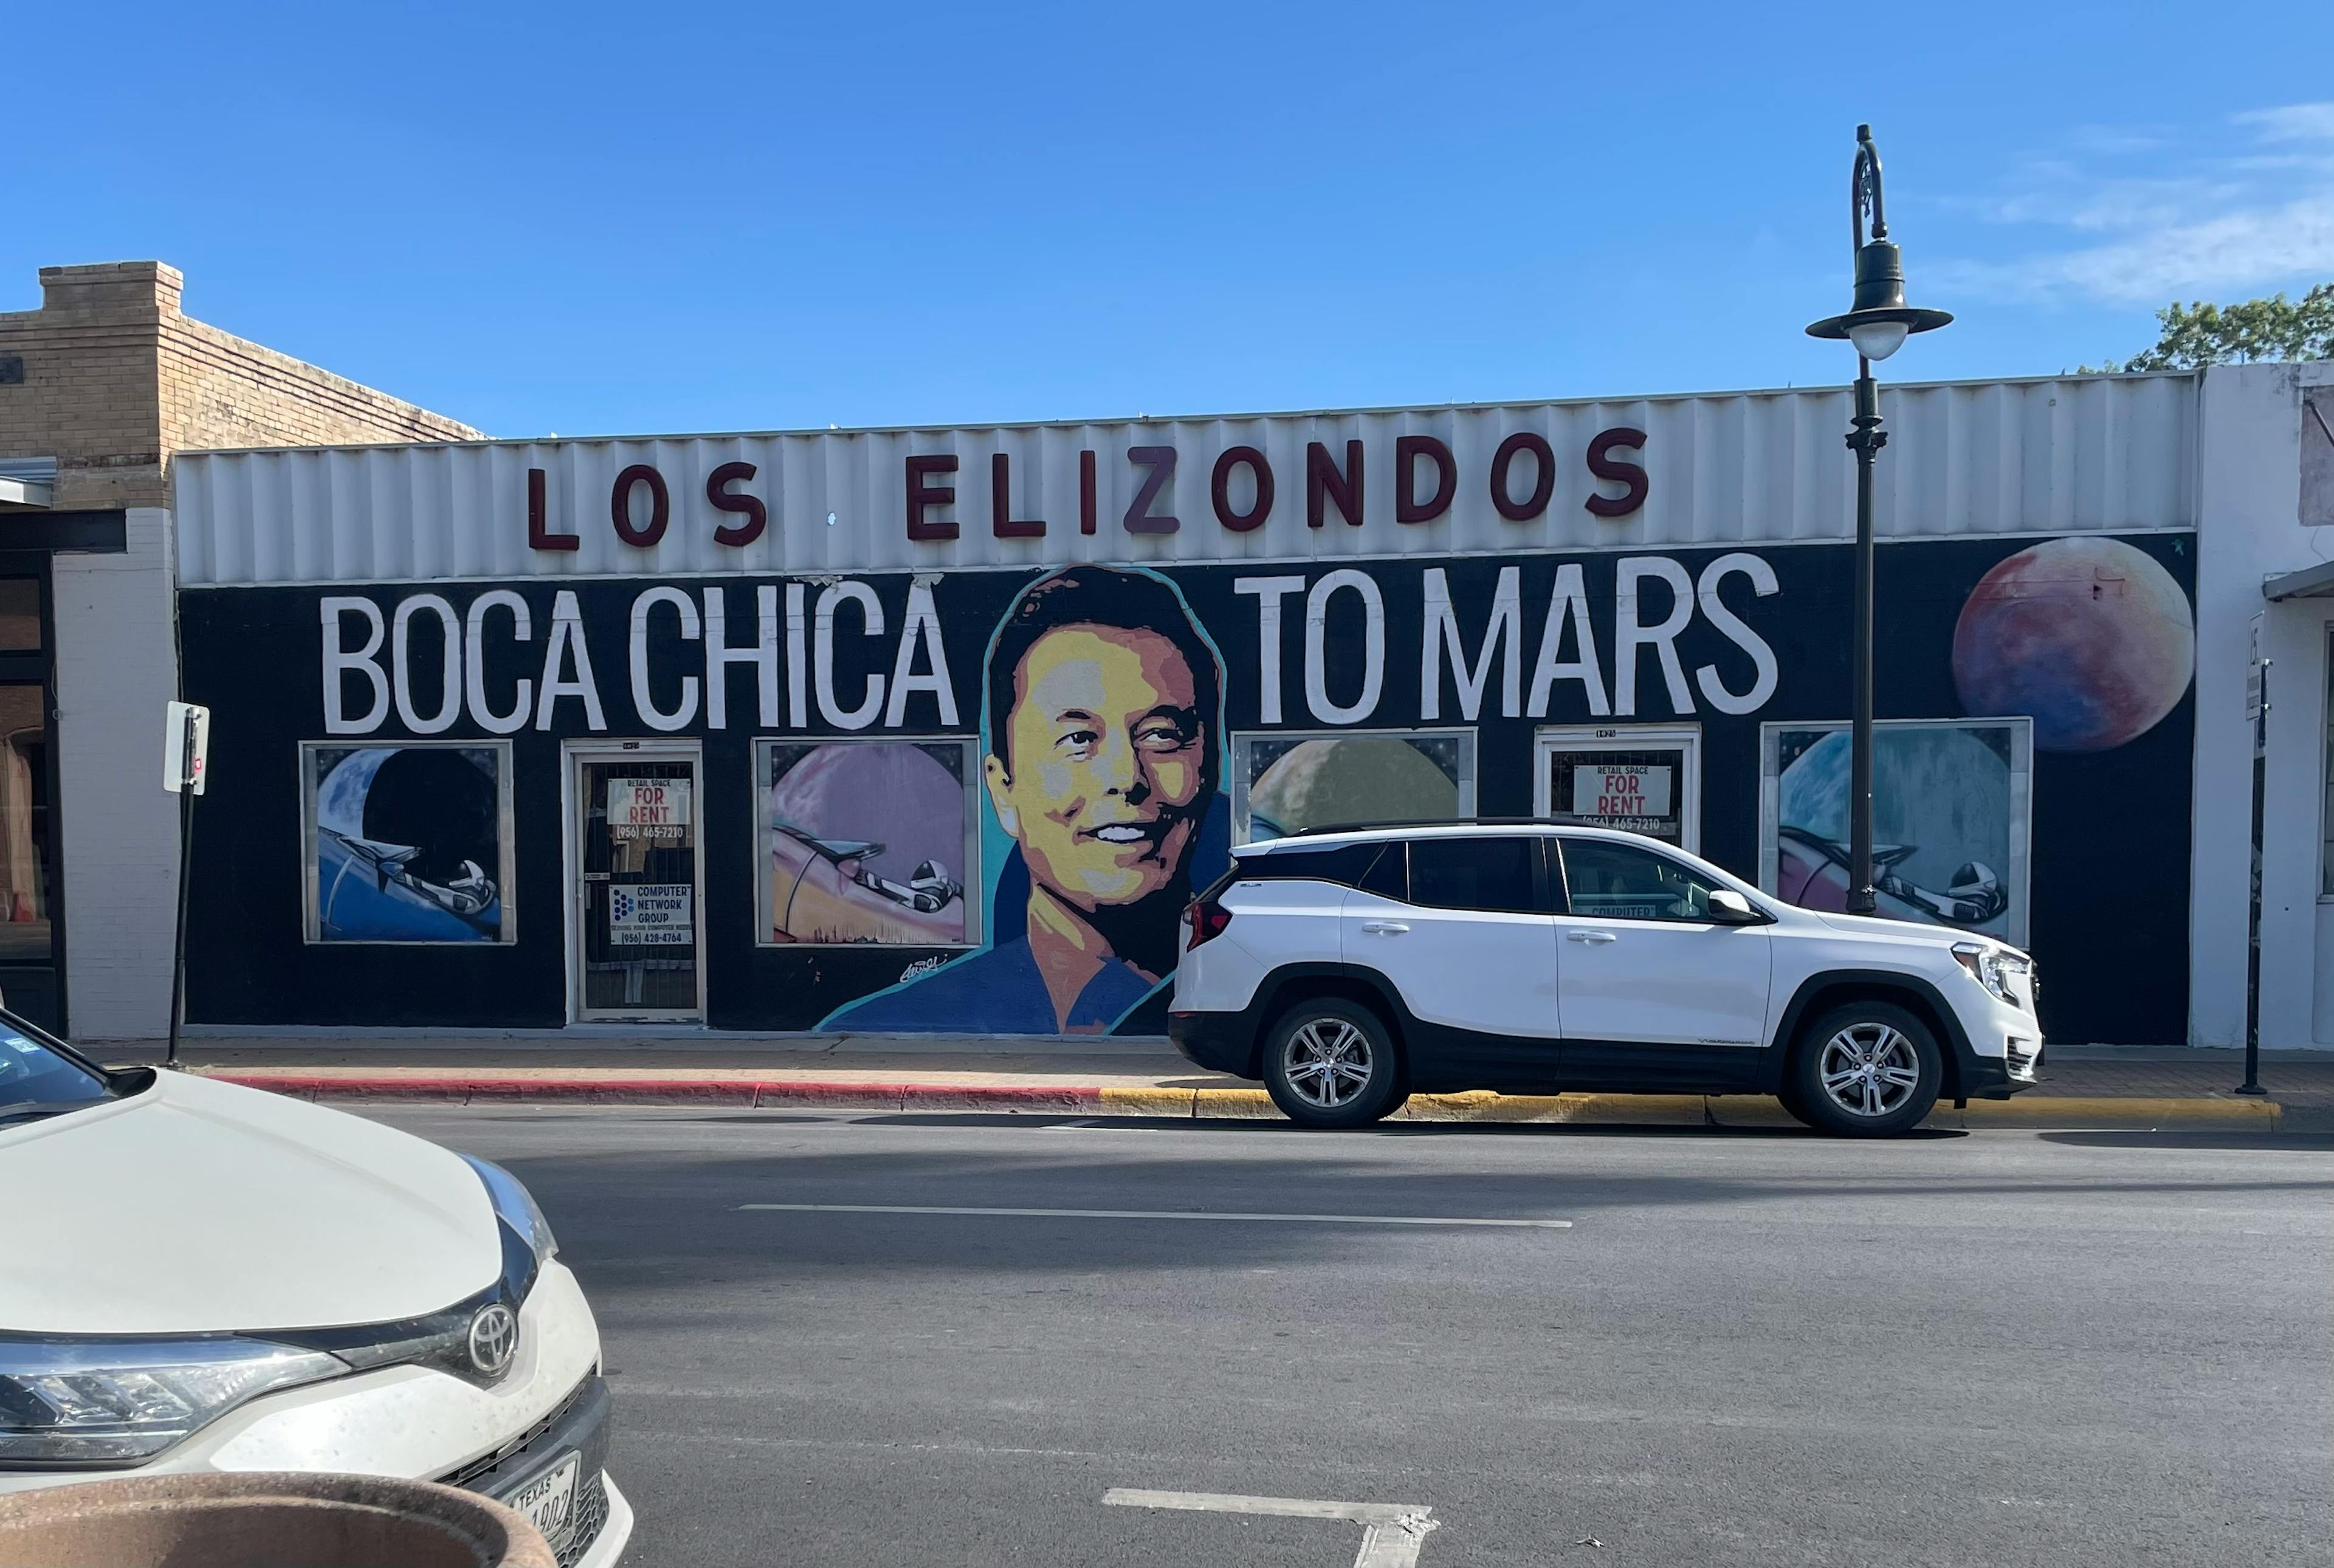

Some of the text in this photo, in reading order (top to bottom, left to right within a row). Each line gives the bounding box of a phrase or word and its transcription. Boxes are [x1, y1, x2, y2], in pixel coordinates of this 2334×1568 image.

[528, 427, 1649, 551] LOS ELIZONDOS
[320, 553, 1780, 734] BOCA CHICA TO MARS
[1626, 766, 1649, 775] SPACE
[1605, 775, 1639, 794] FOR
[635, 788, 664, 805] FOR
[1598, 796, 1646, 814] RENT
[630, 806, 670, 824] RENT
[1613, 817, 1661, 830] 465-7210
[617, 825, 683, 839] (956) 465-7210
[638, 886, 687, 897] COMPUTER
[638, 899, 682, 910] NETWORK
[638, 913, 669, 923] GROUP
[622, 932, 681, 944] (956) 428-4764
[520, 1477, 551, 1511] TEXAS
